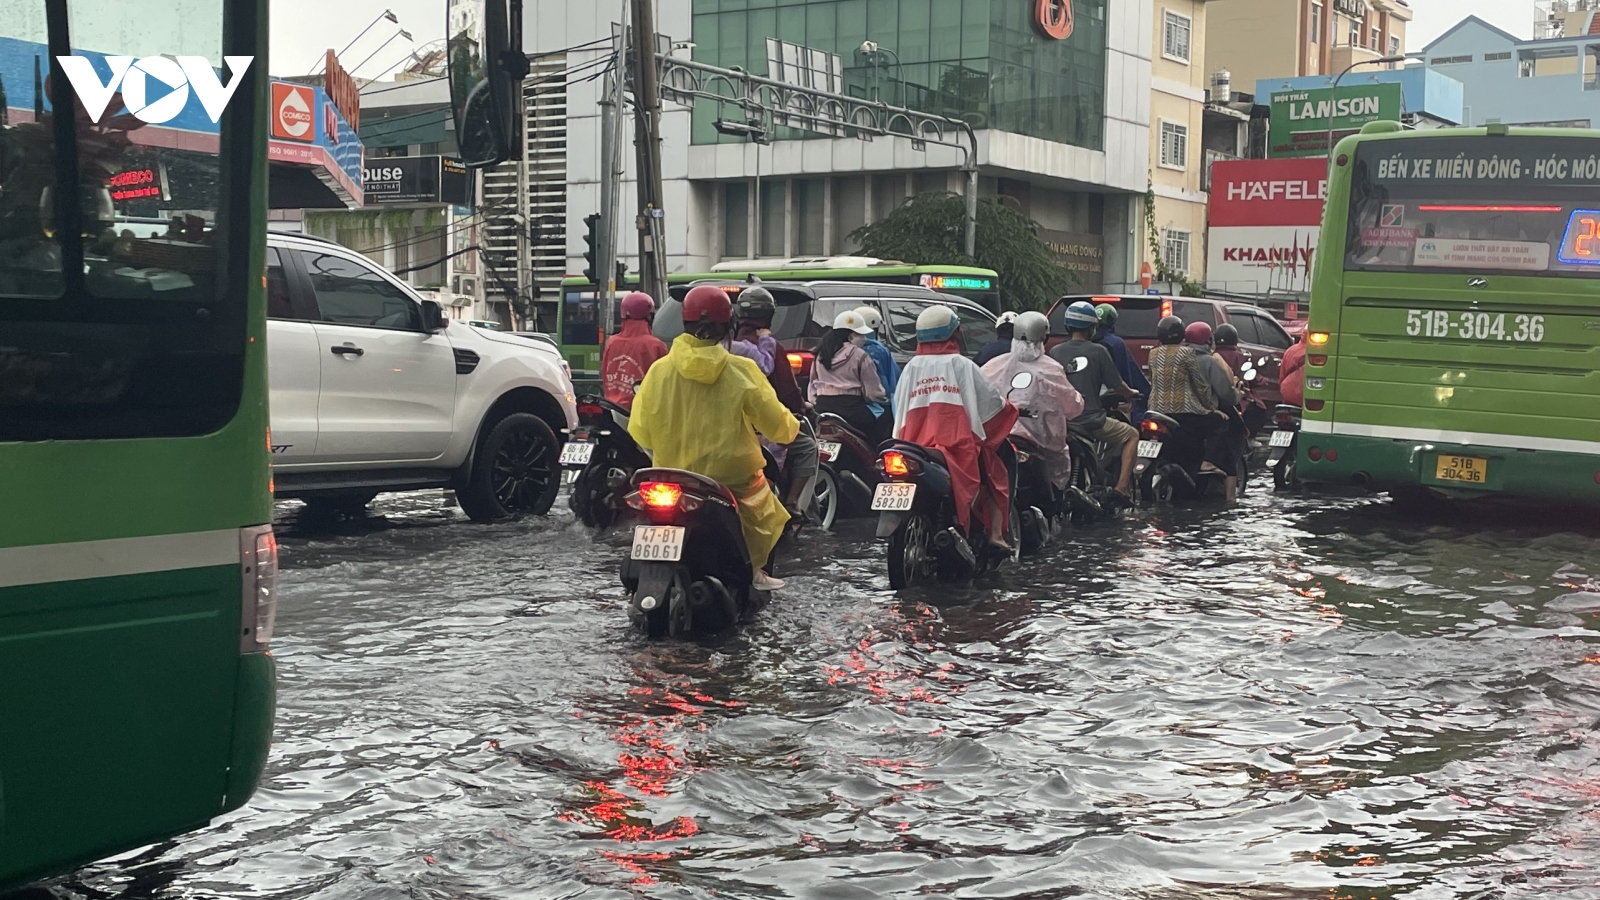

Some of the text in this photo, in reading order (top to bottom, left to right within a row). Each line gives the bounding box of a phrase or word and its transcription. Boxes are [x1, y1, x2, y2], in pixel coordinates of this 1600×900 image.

[283, 111, 311, 121] COMECO
[269, 146, 281, 155] ISO
[1378, 153, 1408, 179] BẾN
[1411, 159, 1432, 179] XE
[1435, 152, 1474, 179] MIỀN
[1477, 156, 1521, 179] ĐÔNG
[1534, 155, 1568, 179] HÓC
[1572, 155, 1600, 179] MÔ
[1367, 229, 1414, 237] AGRIBANK
[1406, 309, 1545, 342] 51B-304.36
[1451, 457, 1473, 469] 51B
[1441, 467, 1481, 481] 304.36
[882, 486, 910, 497] 59-S3
[642, 528, 677, 543] 47-B1
[635, 544, 678, 559] 860.61
